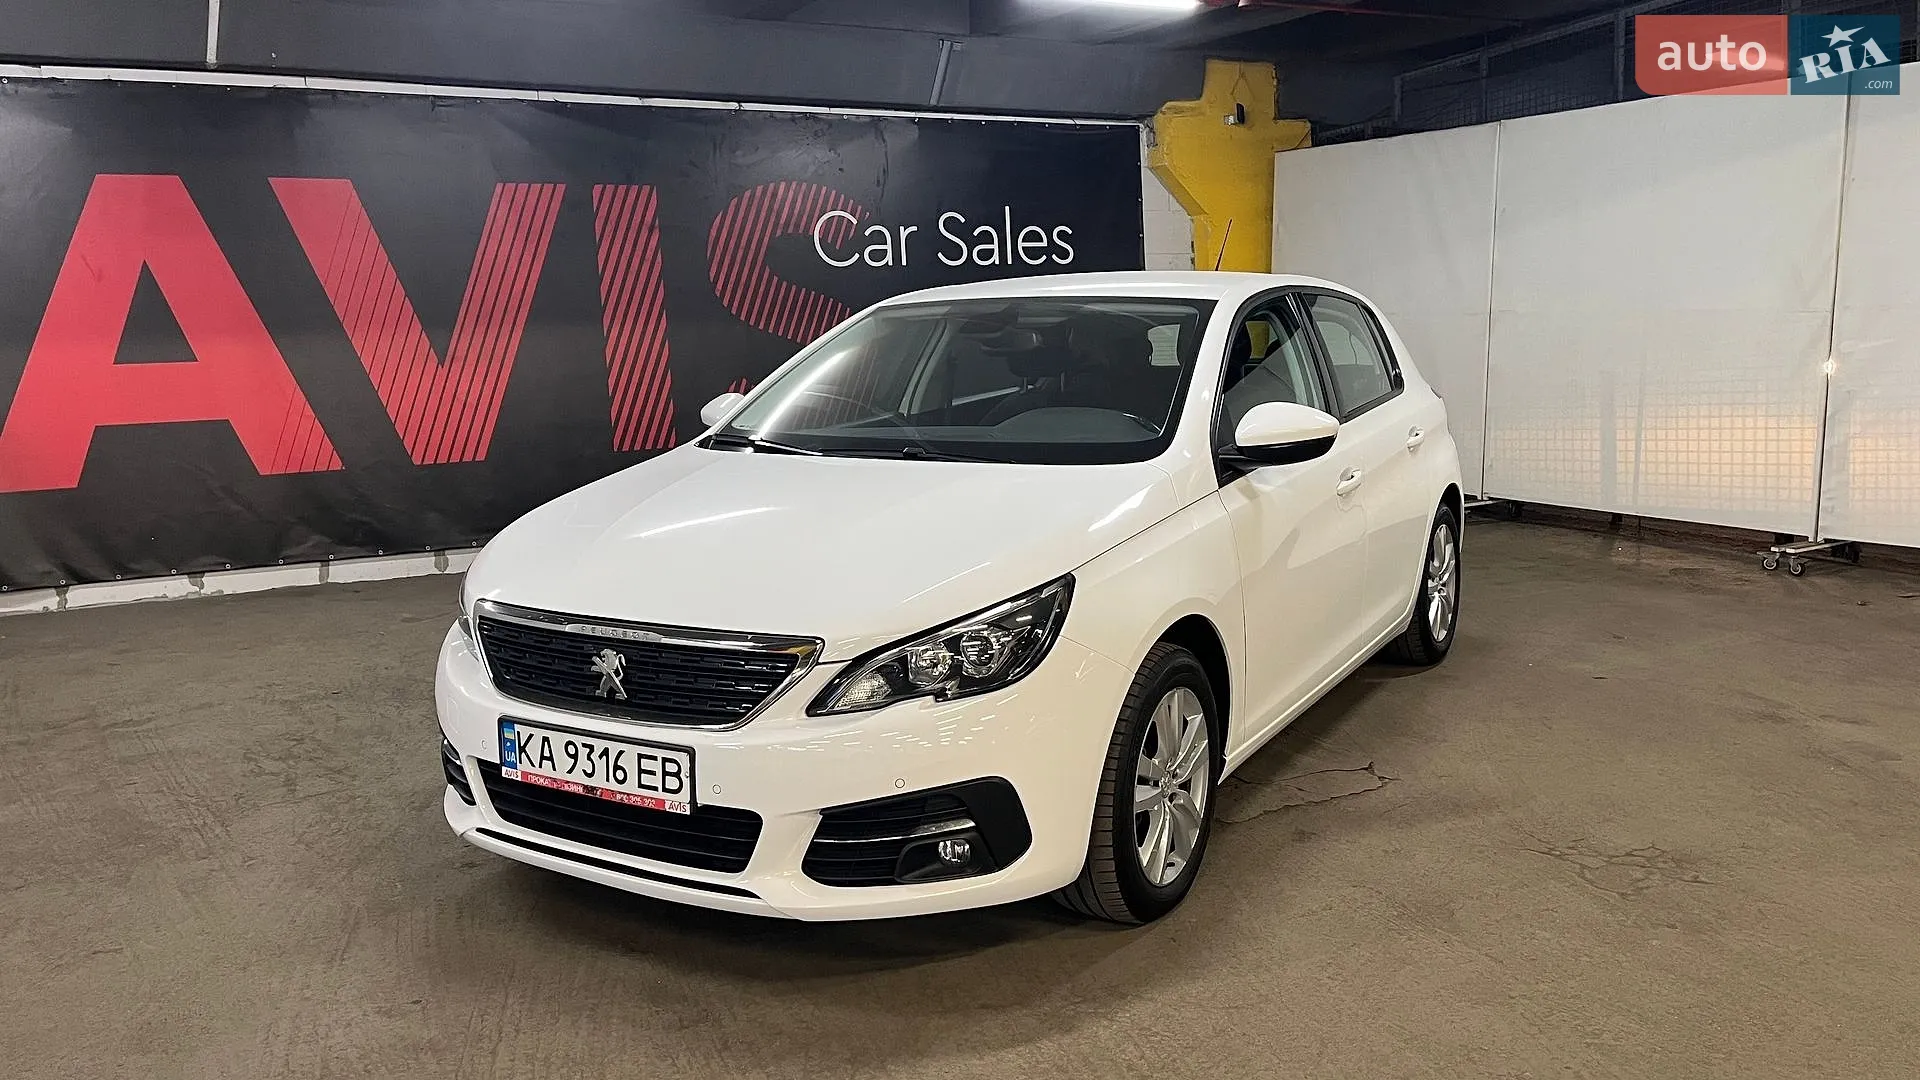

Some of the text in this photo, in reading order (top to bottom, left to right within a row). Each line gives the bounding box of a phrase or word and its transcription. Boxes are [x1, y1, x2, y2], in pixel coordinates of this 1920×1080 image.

[813, 205, 1074, 268] Car Sales
[0, 174, 870, 493] AVIS
[505, 747, 517, 763] UA
[516, 730, 684, 795] KA 9316 EB
